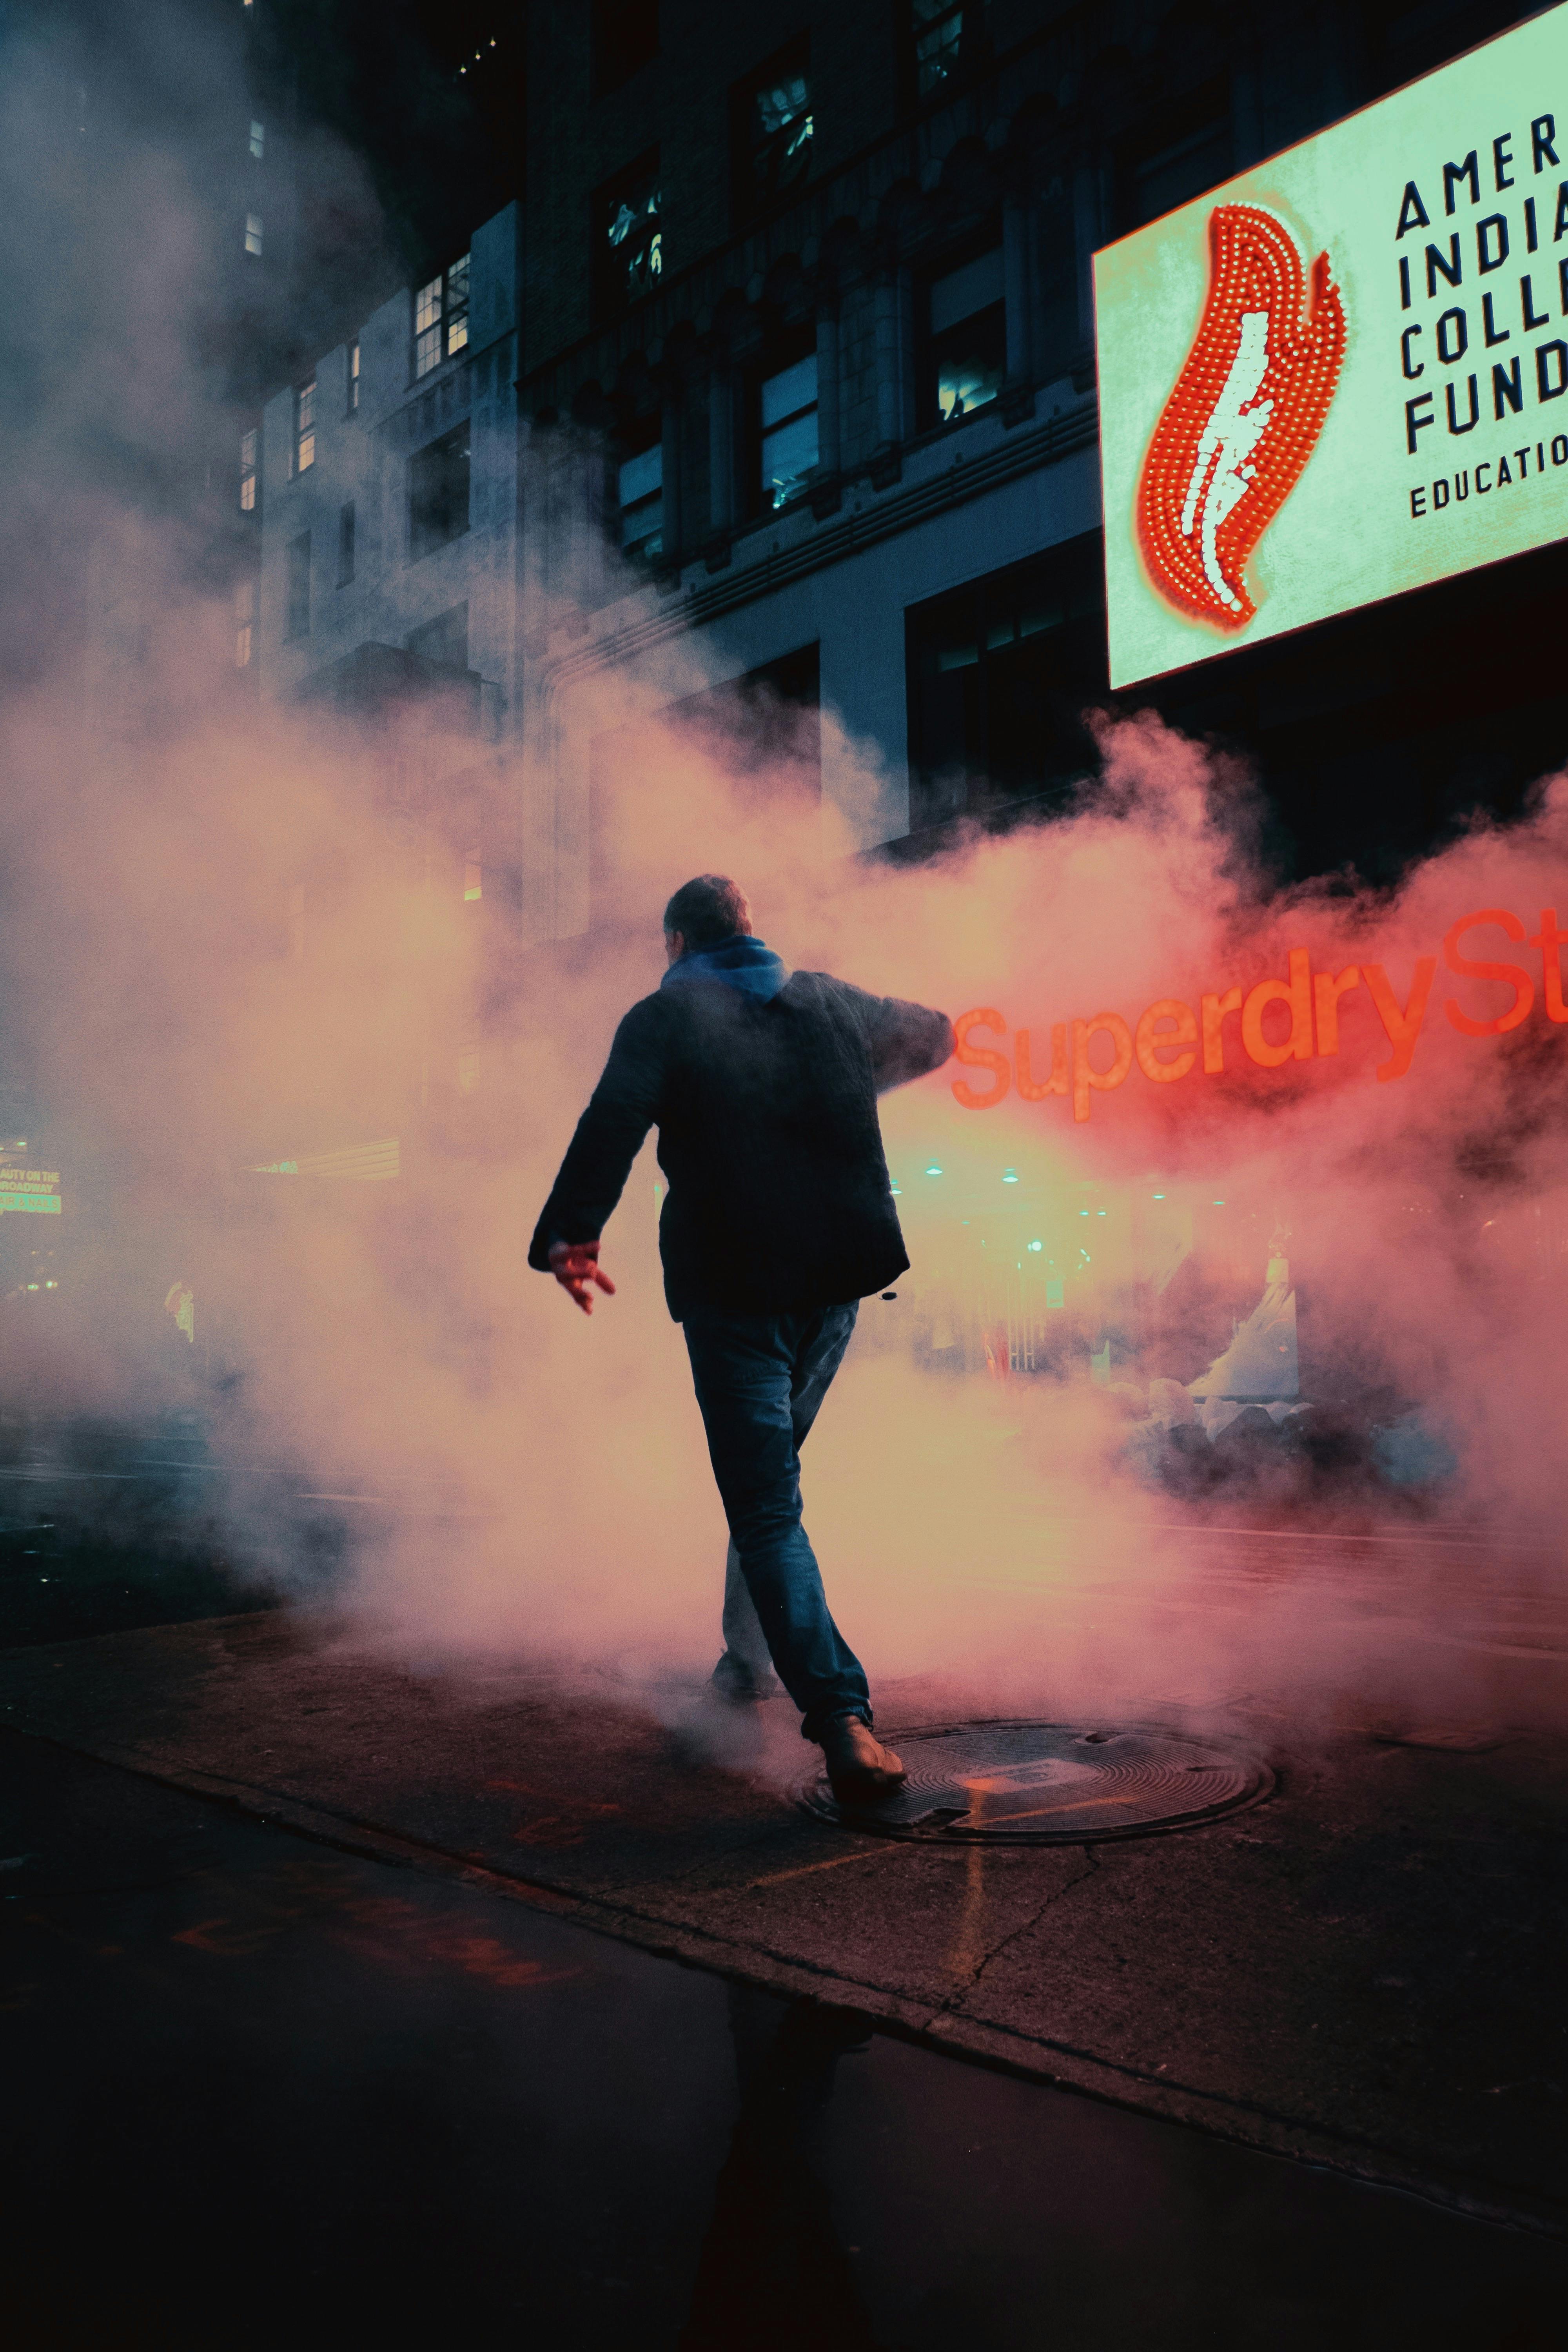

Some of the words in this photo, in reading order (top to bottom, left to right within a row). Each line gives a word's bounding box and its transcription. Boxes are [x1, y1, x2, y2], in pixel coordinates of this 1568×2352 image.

[1396, 114, 1560, 241] AMER
[1405, 339, 1568, 454] FUND
[1410, 434, 1568, 519] EDUCATIO
[951, 946, 1437, 1123] Superdry
[0, 1181, 53, 1193] ROADWAY
[19, 1197, 25, 1207] &
[28, 1198, 57, 1208] NAILS
[26, 1171, 40, 1181] ON
[42, 1171, 60, 1182] THE
